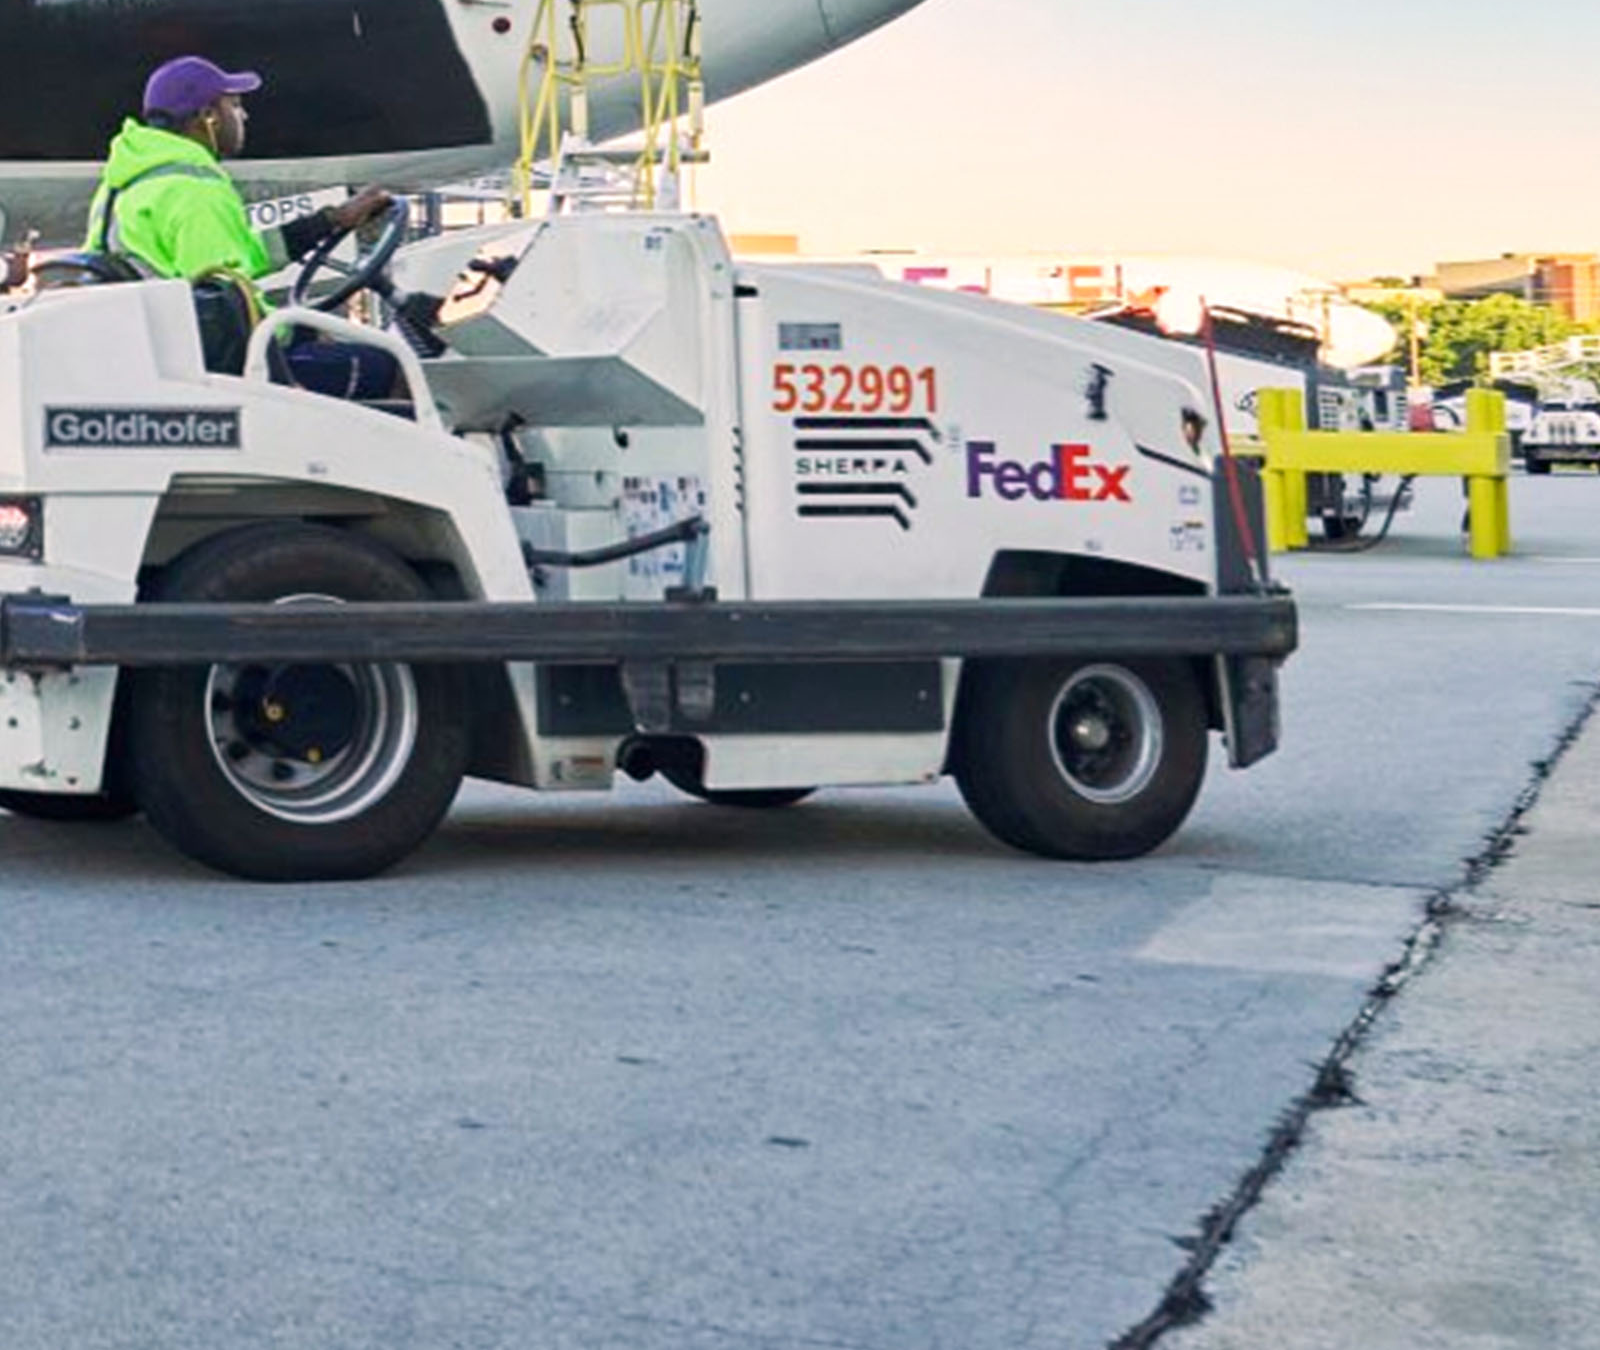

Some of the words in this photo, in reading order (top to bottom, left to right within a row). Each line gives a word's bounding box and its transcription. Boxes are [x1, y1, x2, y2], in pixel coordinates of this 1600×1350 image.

[772, 363, 937, 414] 532991
[51, 412, 235, 443] Goldhofer
[795, 457, 909, 476] SHERPA
[966, 441, 1132, 501] FedEx
